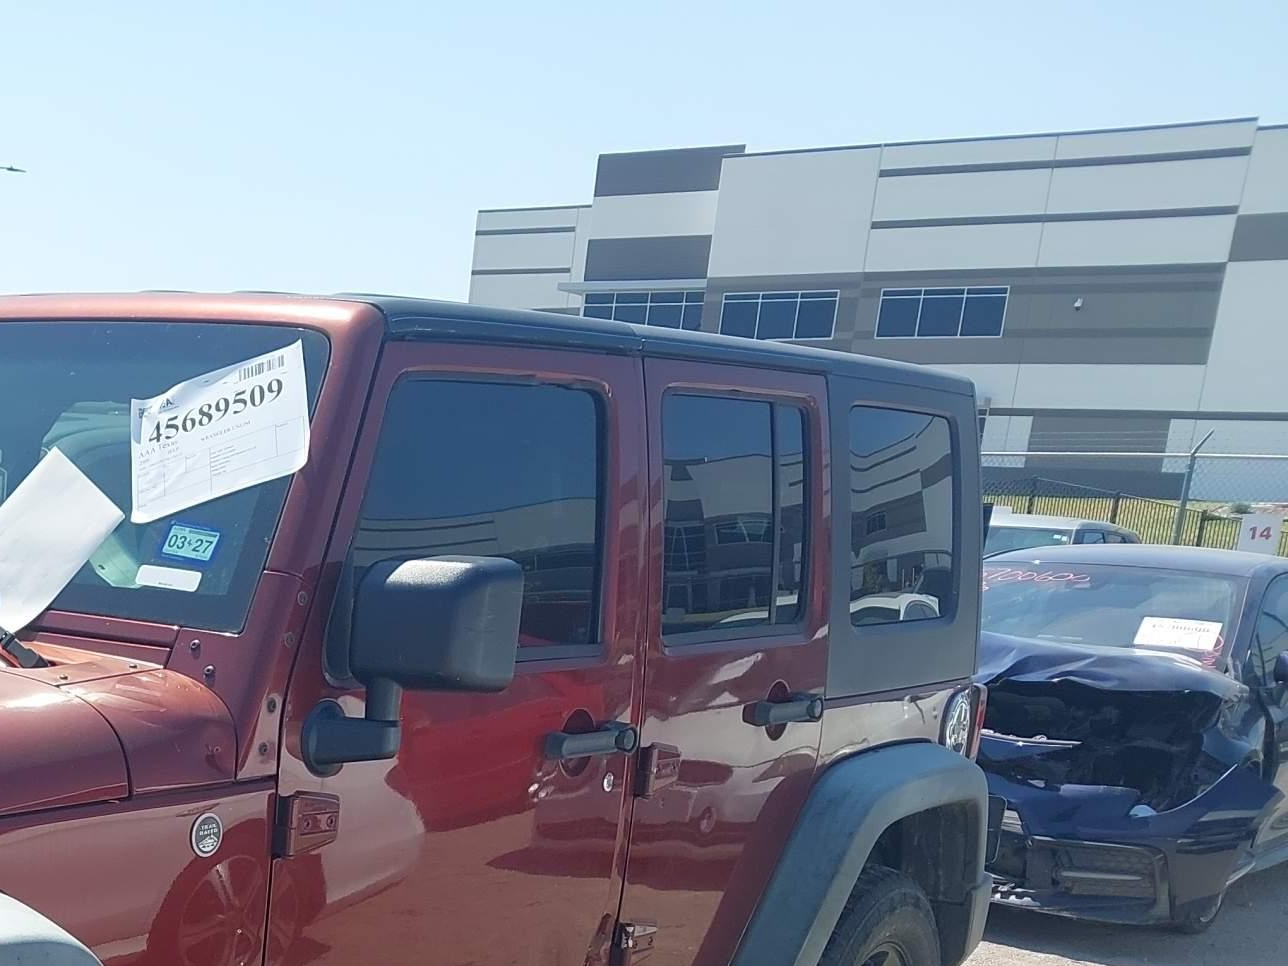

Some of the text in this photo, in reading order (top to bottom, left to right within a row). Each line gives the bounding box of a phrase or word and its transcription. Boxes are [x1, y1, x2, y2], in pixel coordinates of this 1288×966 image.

[148, 378, 283, 443] 45689509
[1249, 526, 1272, 540] 14
[168, 534, 214, 553] 03 27
